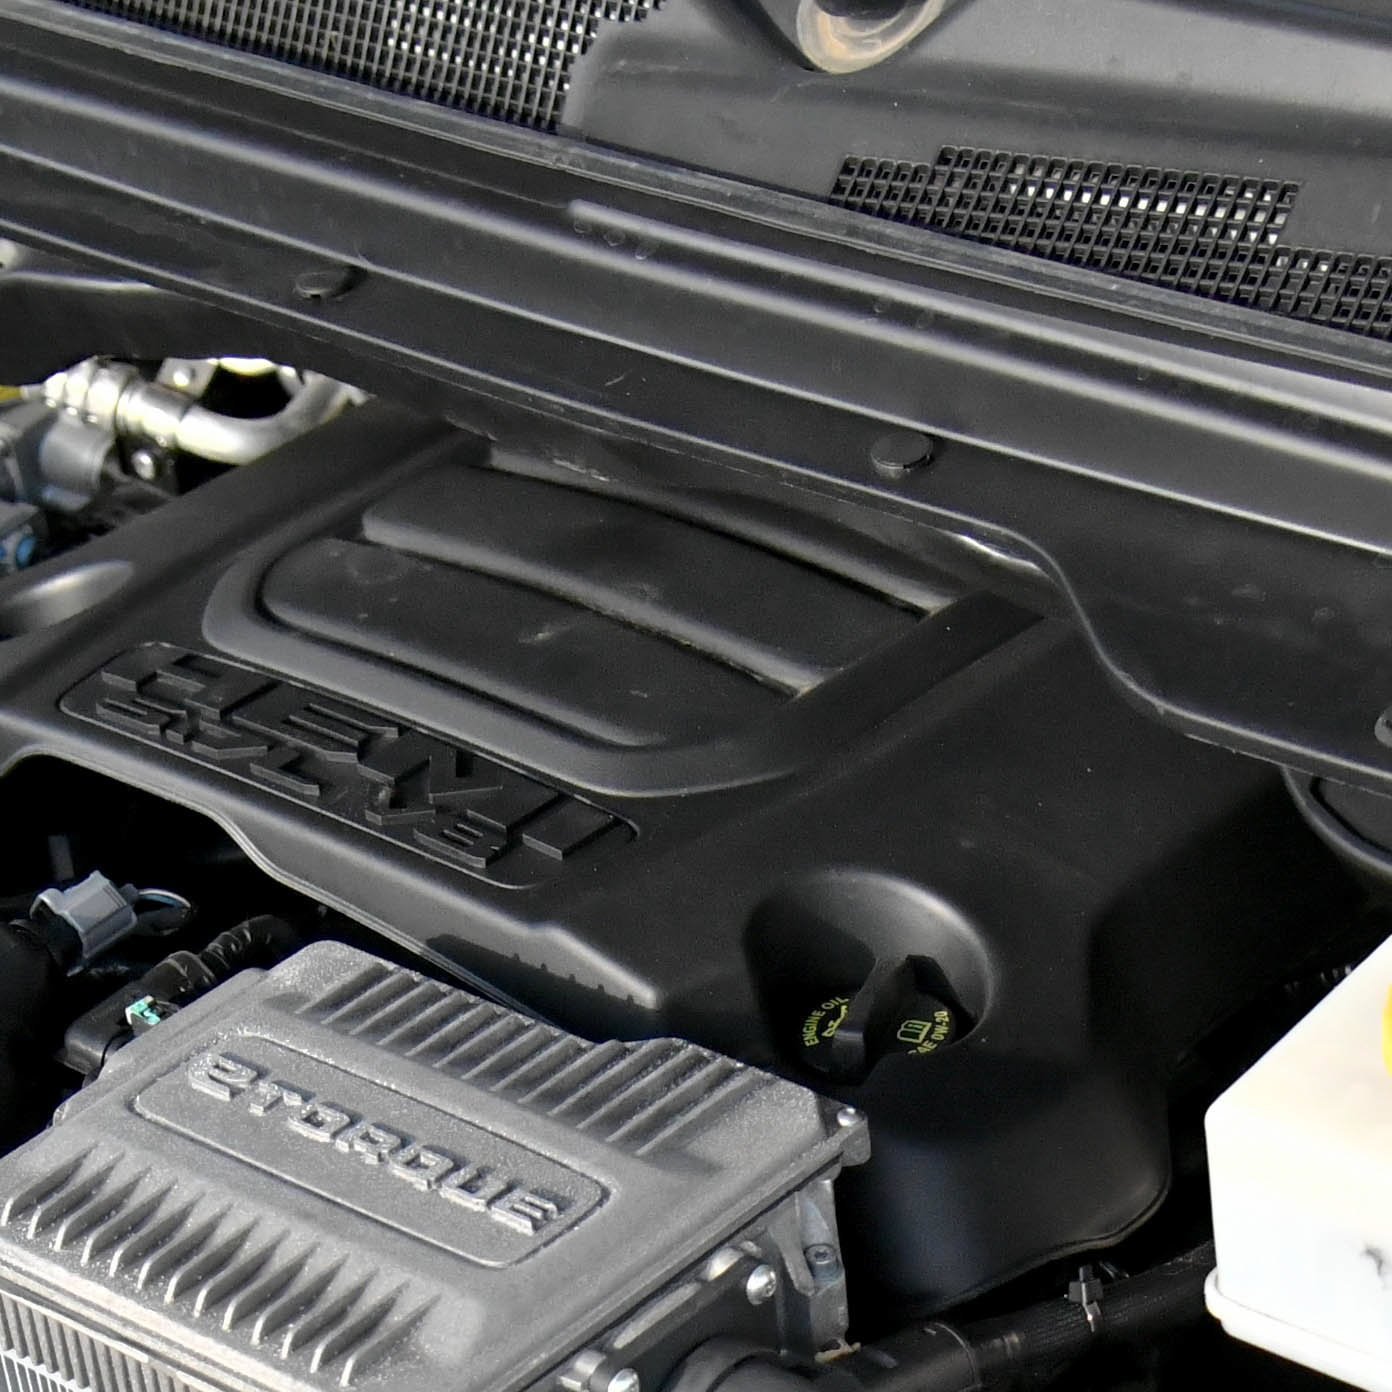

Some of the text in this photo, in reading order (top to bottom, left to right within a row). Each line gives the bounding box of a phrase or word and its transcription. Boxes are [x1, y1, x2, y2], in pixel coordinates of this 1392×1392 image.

[100, 654, 622, 862] HEMI
[802, 996, 849, 1047] ENGINE OIL
[930, 1010, 950, 1041] 0W-20
